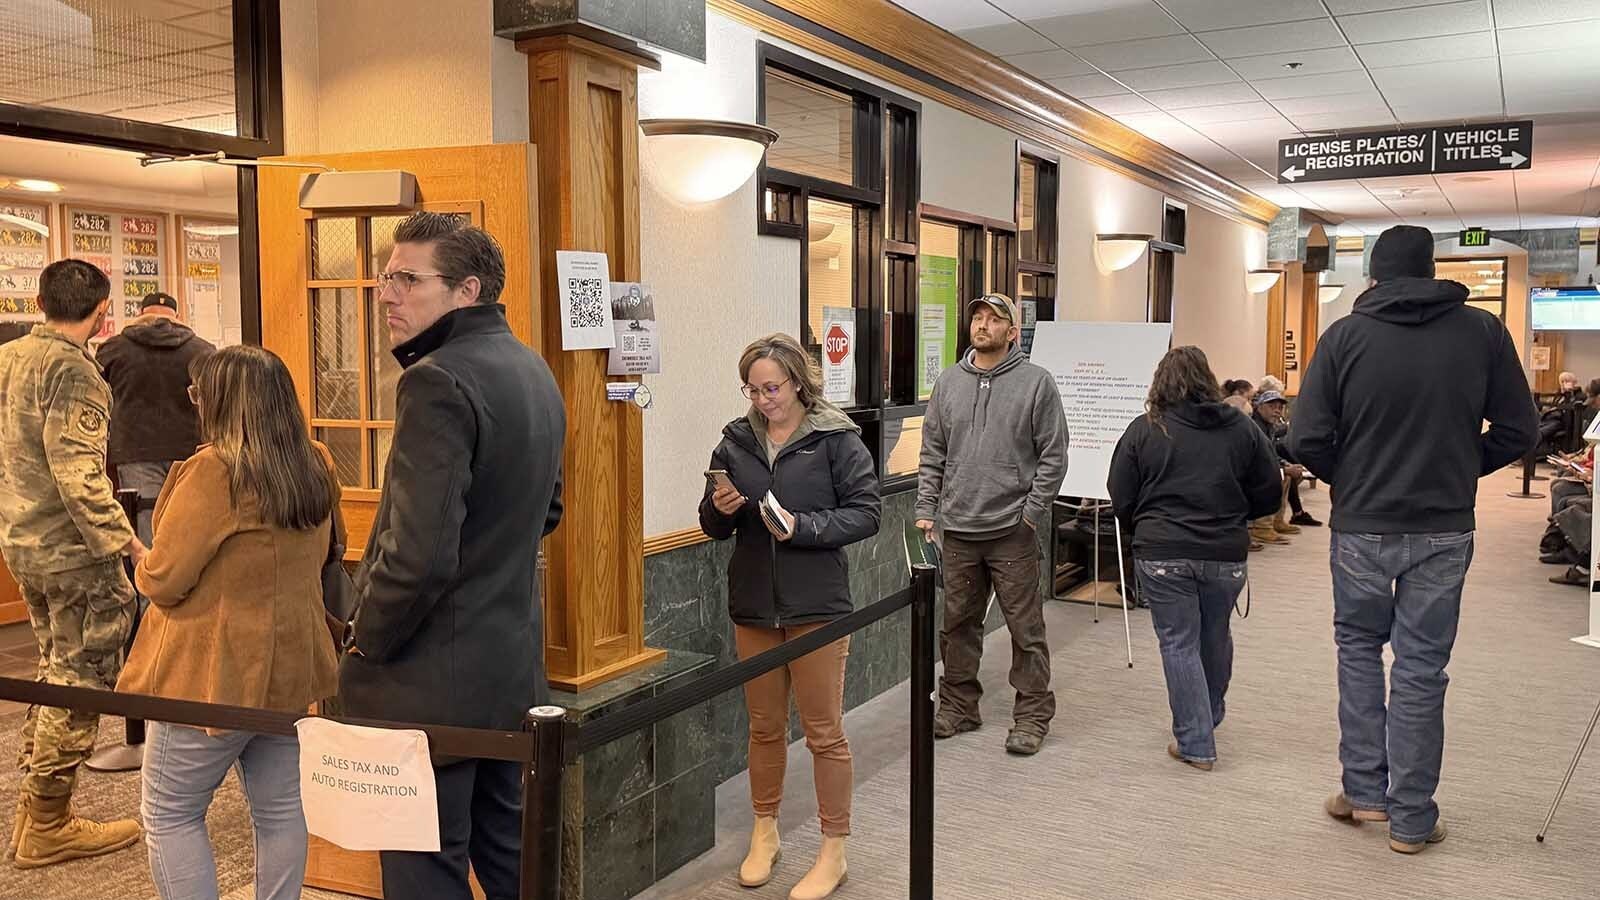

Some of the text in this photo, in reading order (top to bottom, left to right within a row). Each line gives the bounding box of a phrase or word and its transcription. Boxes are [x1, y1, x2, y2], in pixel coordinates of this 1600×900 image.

[1284, 134, 1426, 158] LICENSE PLATES/
[1443, 128, 1520, 146] VEHICLE
[1305, 149, 1424, 170] REGISTRATION
[1443, 145, 1503, 161] TITLES
[1465, 230, 1486, 245] EXIT
[826, 337, 848, 353] STOP
[321, 754, 400, 776] SALES TAX AND
[311, 772, 417, 797] AUTO REGISTRATION
